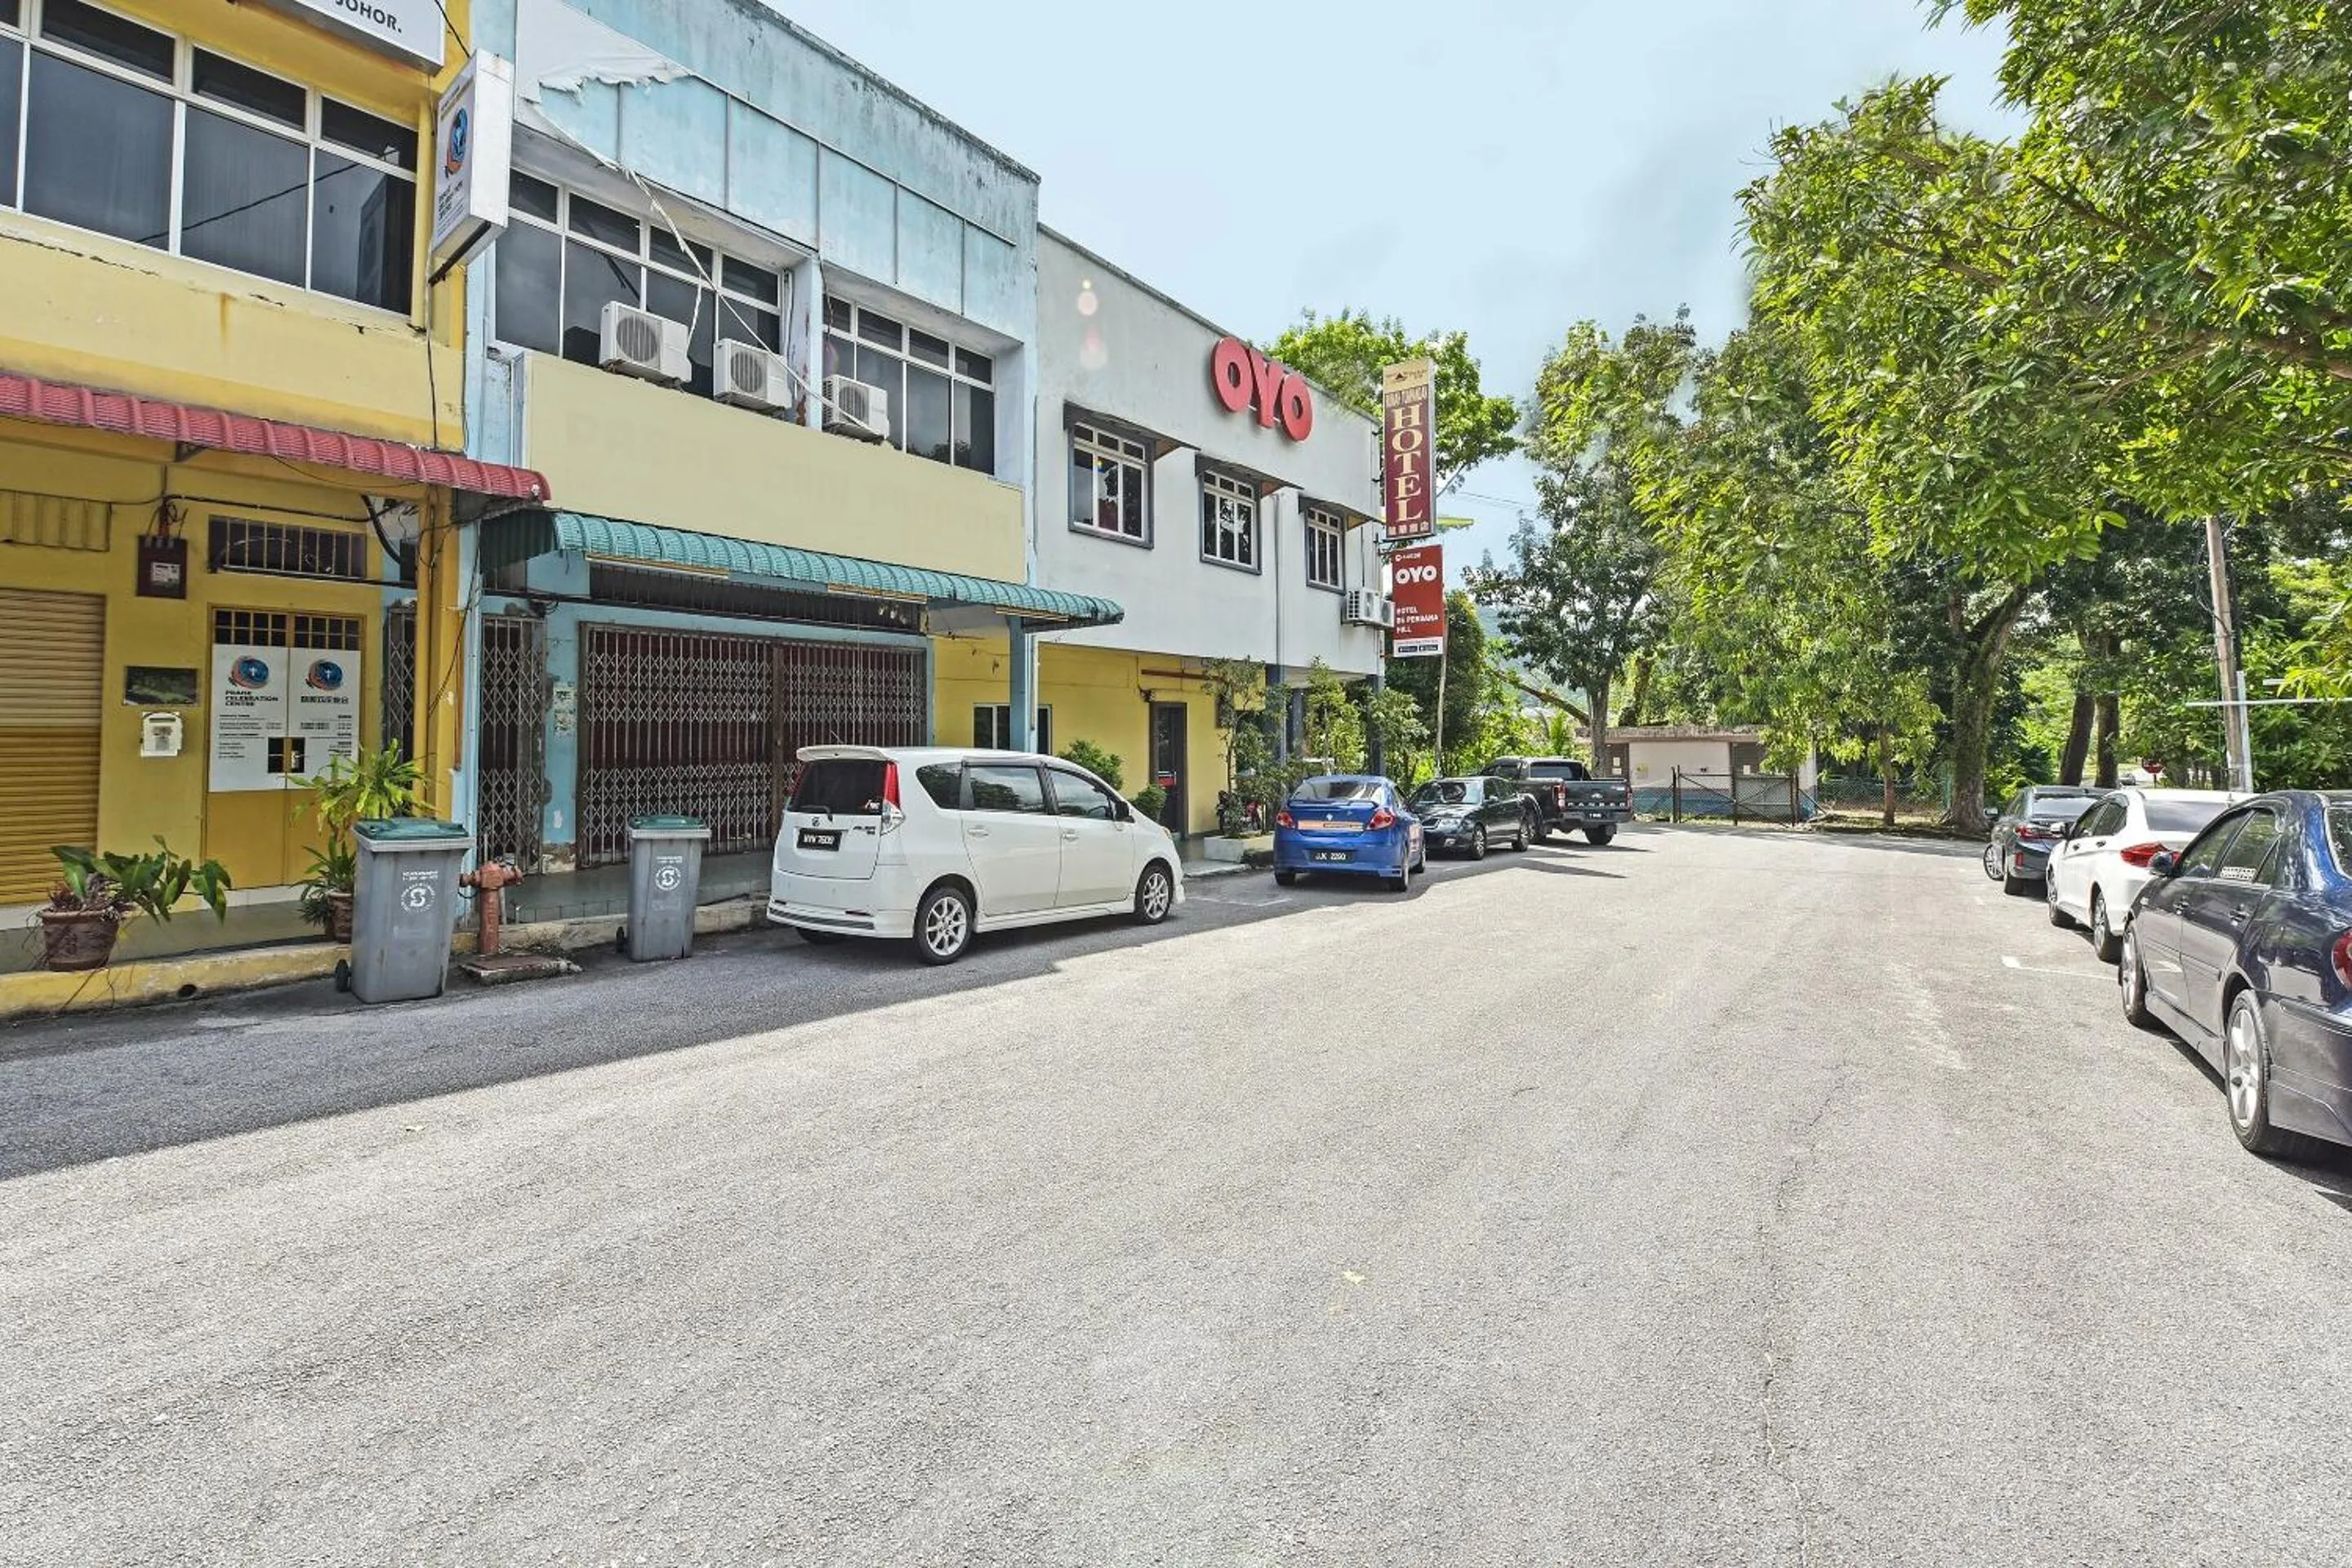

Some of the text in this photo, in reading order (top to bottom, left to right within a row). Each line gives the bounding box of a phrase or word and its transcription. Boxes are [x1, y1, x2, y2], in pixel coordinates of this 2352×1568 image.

[1210, 336, 1313, 442] OYO
[1392, 403, 1423, 523] HOTEL
[1396, 565, 1437, 584] OYO
